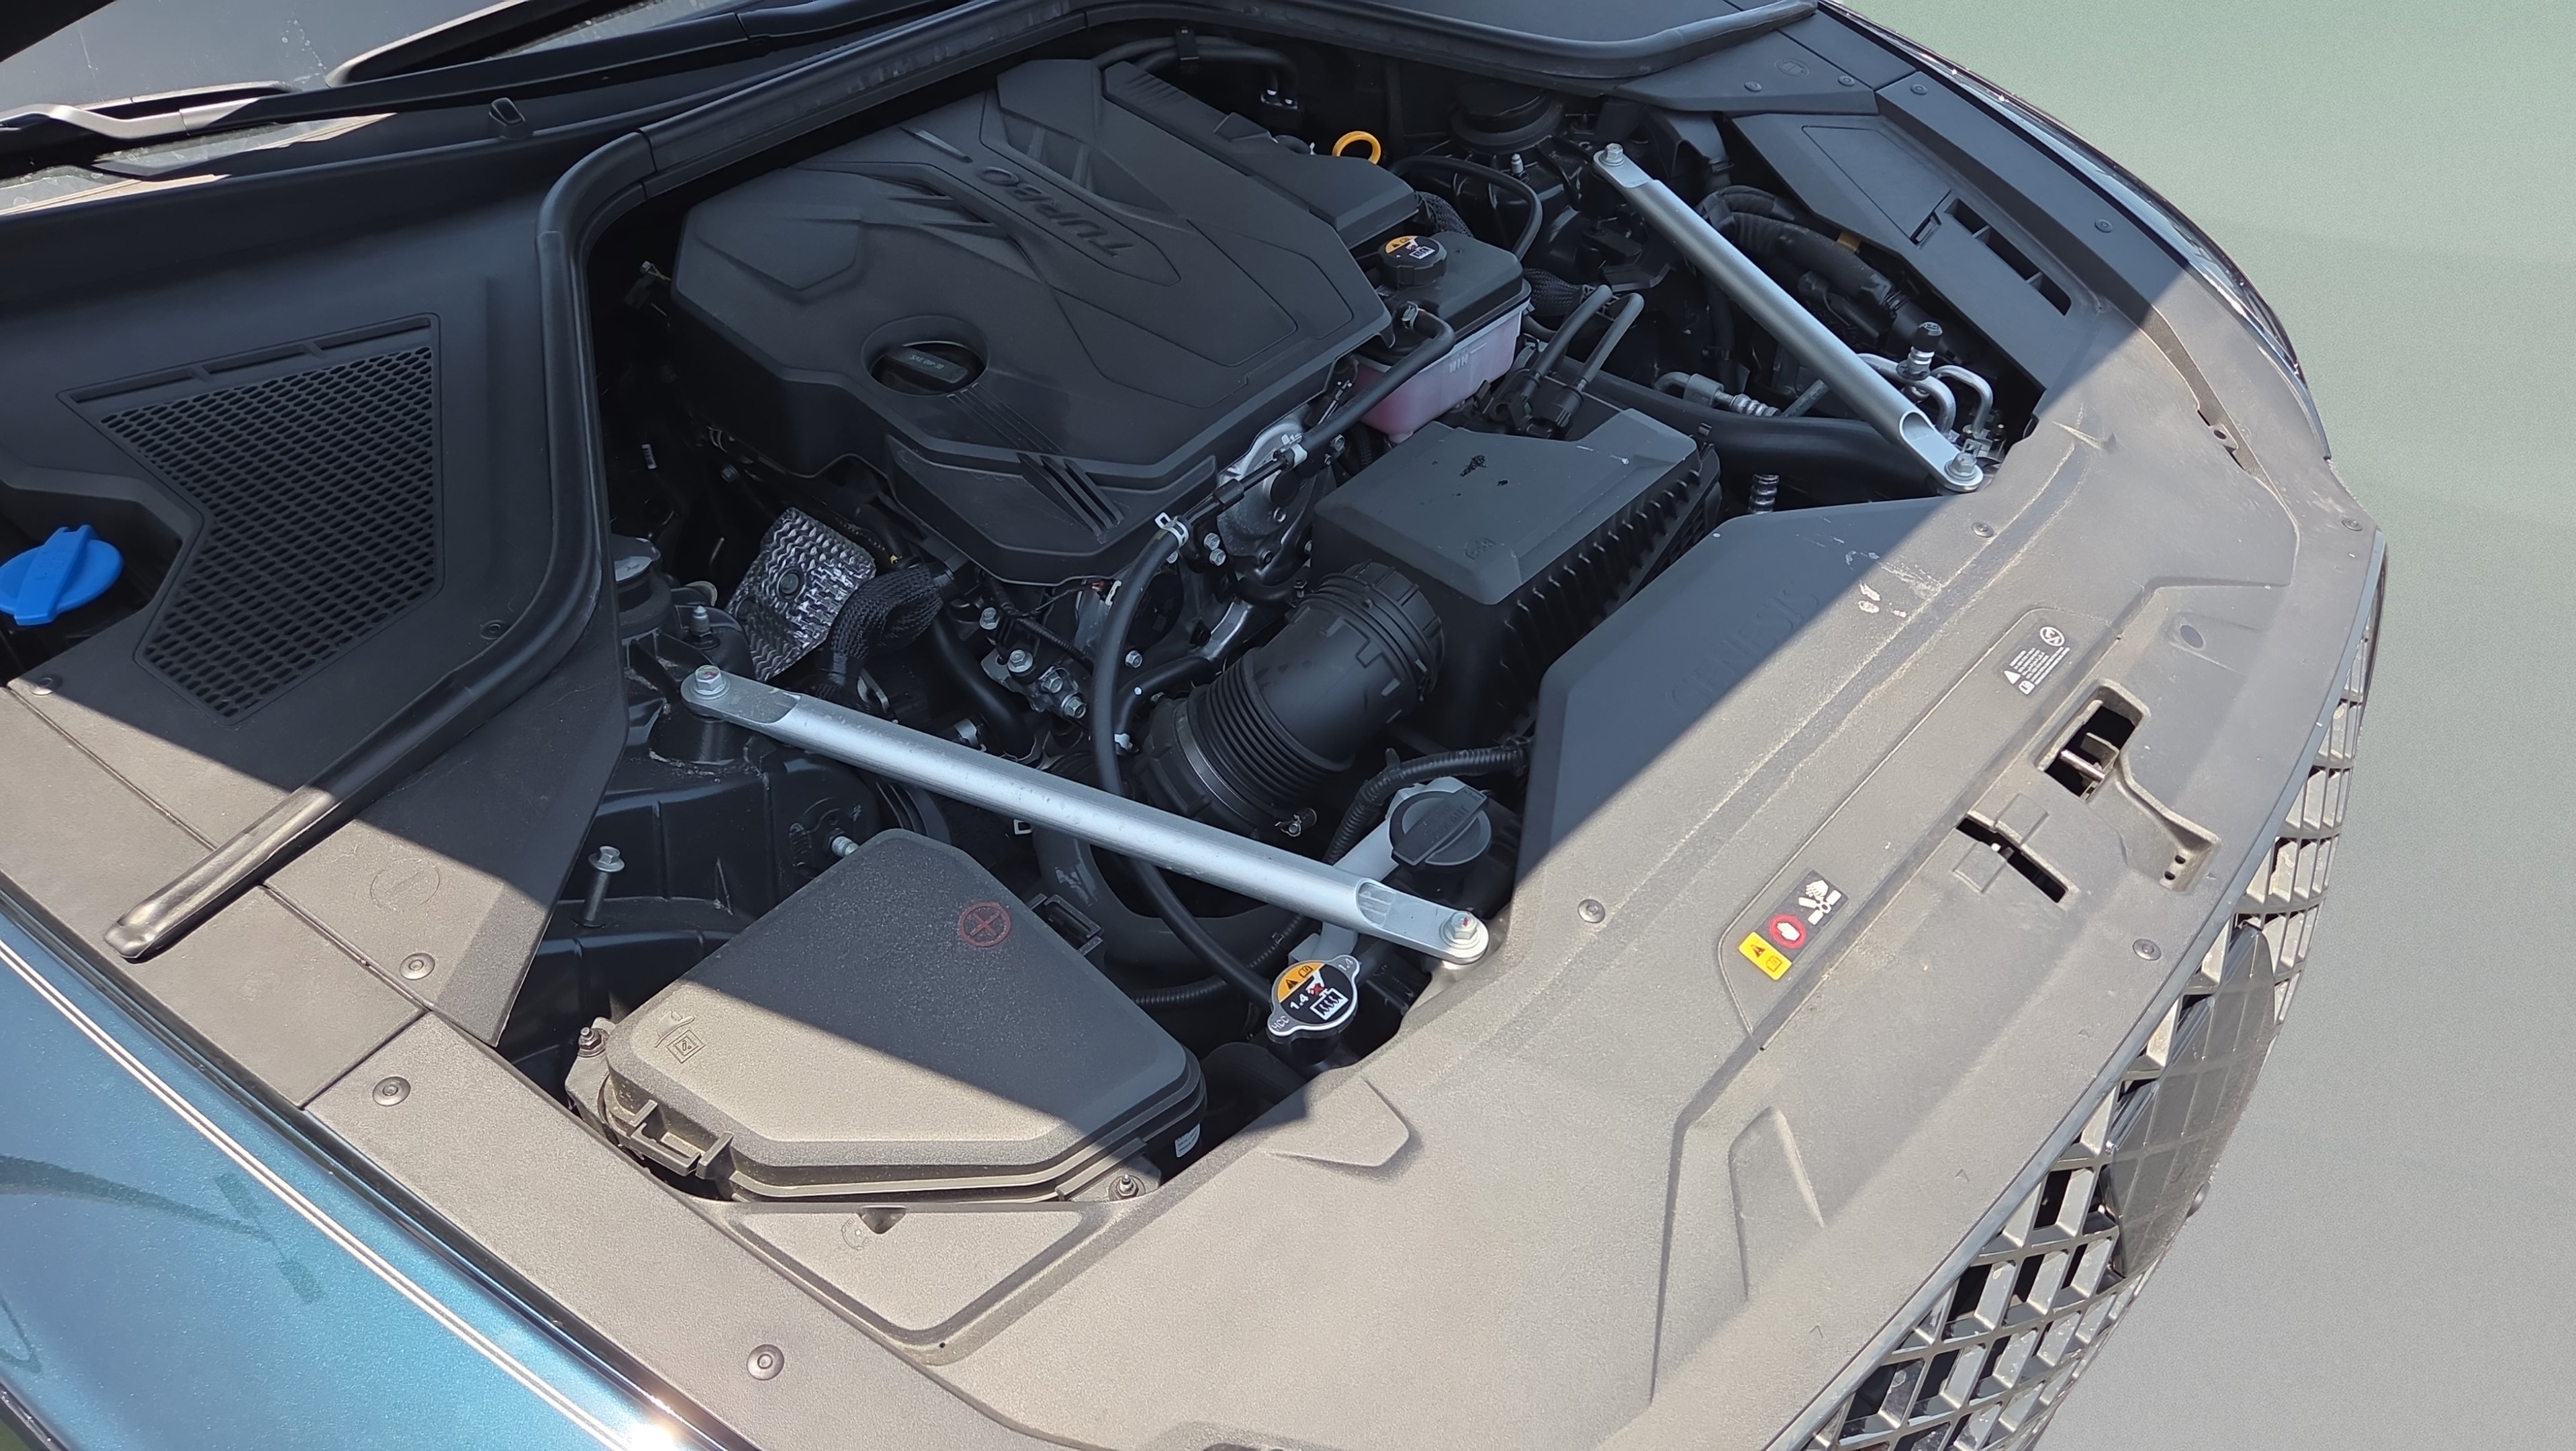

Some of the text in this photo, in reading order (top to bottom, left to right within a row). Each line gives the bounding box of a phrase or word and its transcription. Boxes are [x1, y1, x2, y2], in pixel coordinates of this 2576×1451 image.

[974, 166, 1136, 257] TURBO
[1665, 582, 1819, 711] GENESIS
[1338, 957, 1354, 971] 1.4
[1290, 994, 1309, 1010] 1.4
